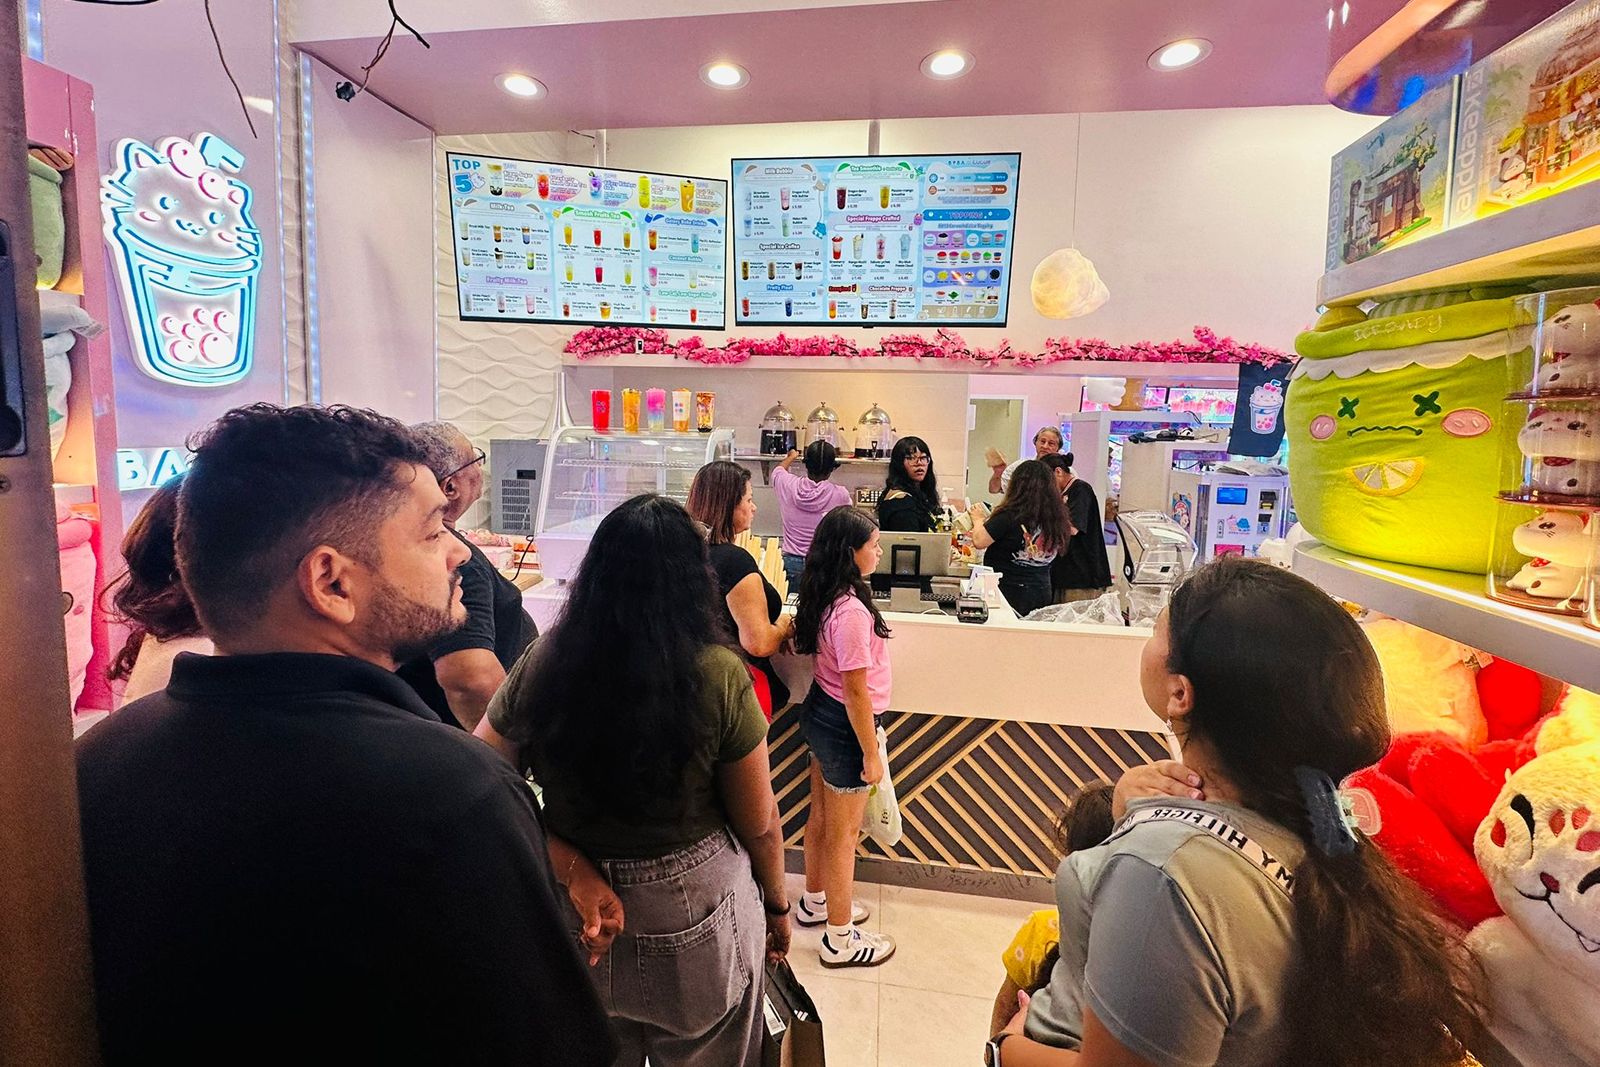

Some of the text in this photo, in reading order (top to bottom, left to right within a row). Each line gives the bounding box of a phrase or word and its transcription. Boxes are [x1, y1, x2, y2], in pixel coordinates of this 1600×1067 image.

[453, 159, 480, 170] TOP
[860, 164, 882, 172] Smoothie
[454, 174, 473, 193] 5
[847, 215, 864, 223] Special
[759, 243, 777, 251] Special
[486, 276, 503, 285] Fruity
[767, 284, 780, 292] Fruity
